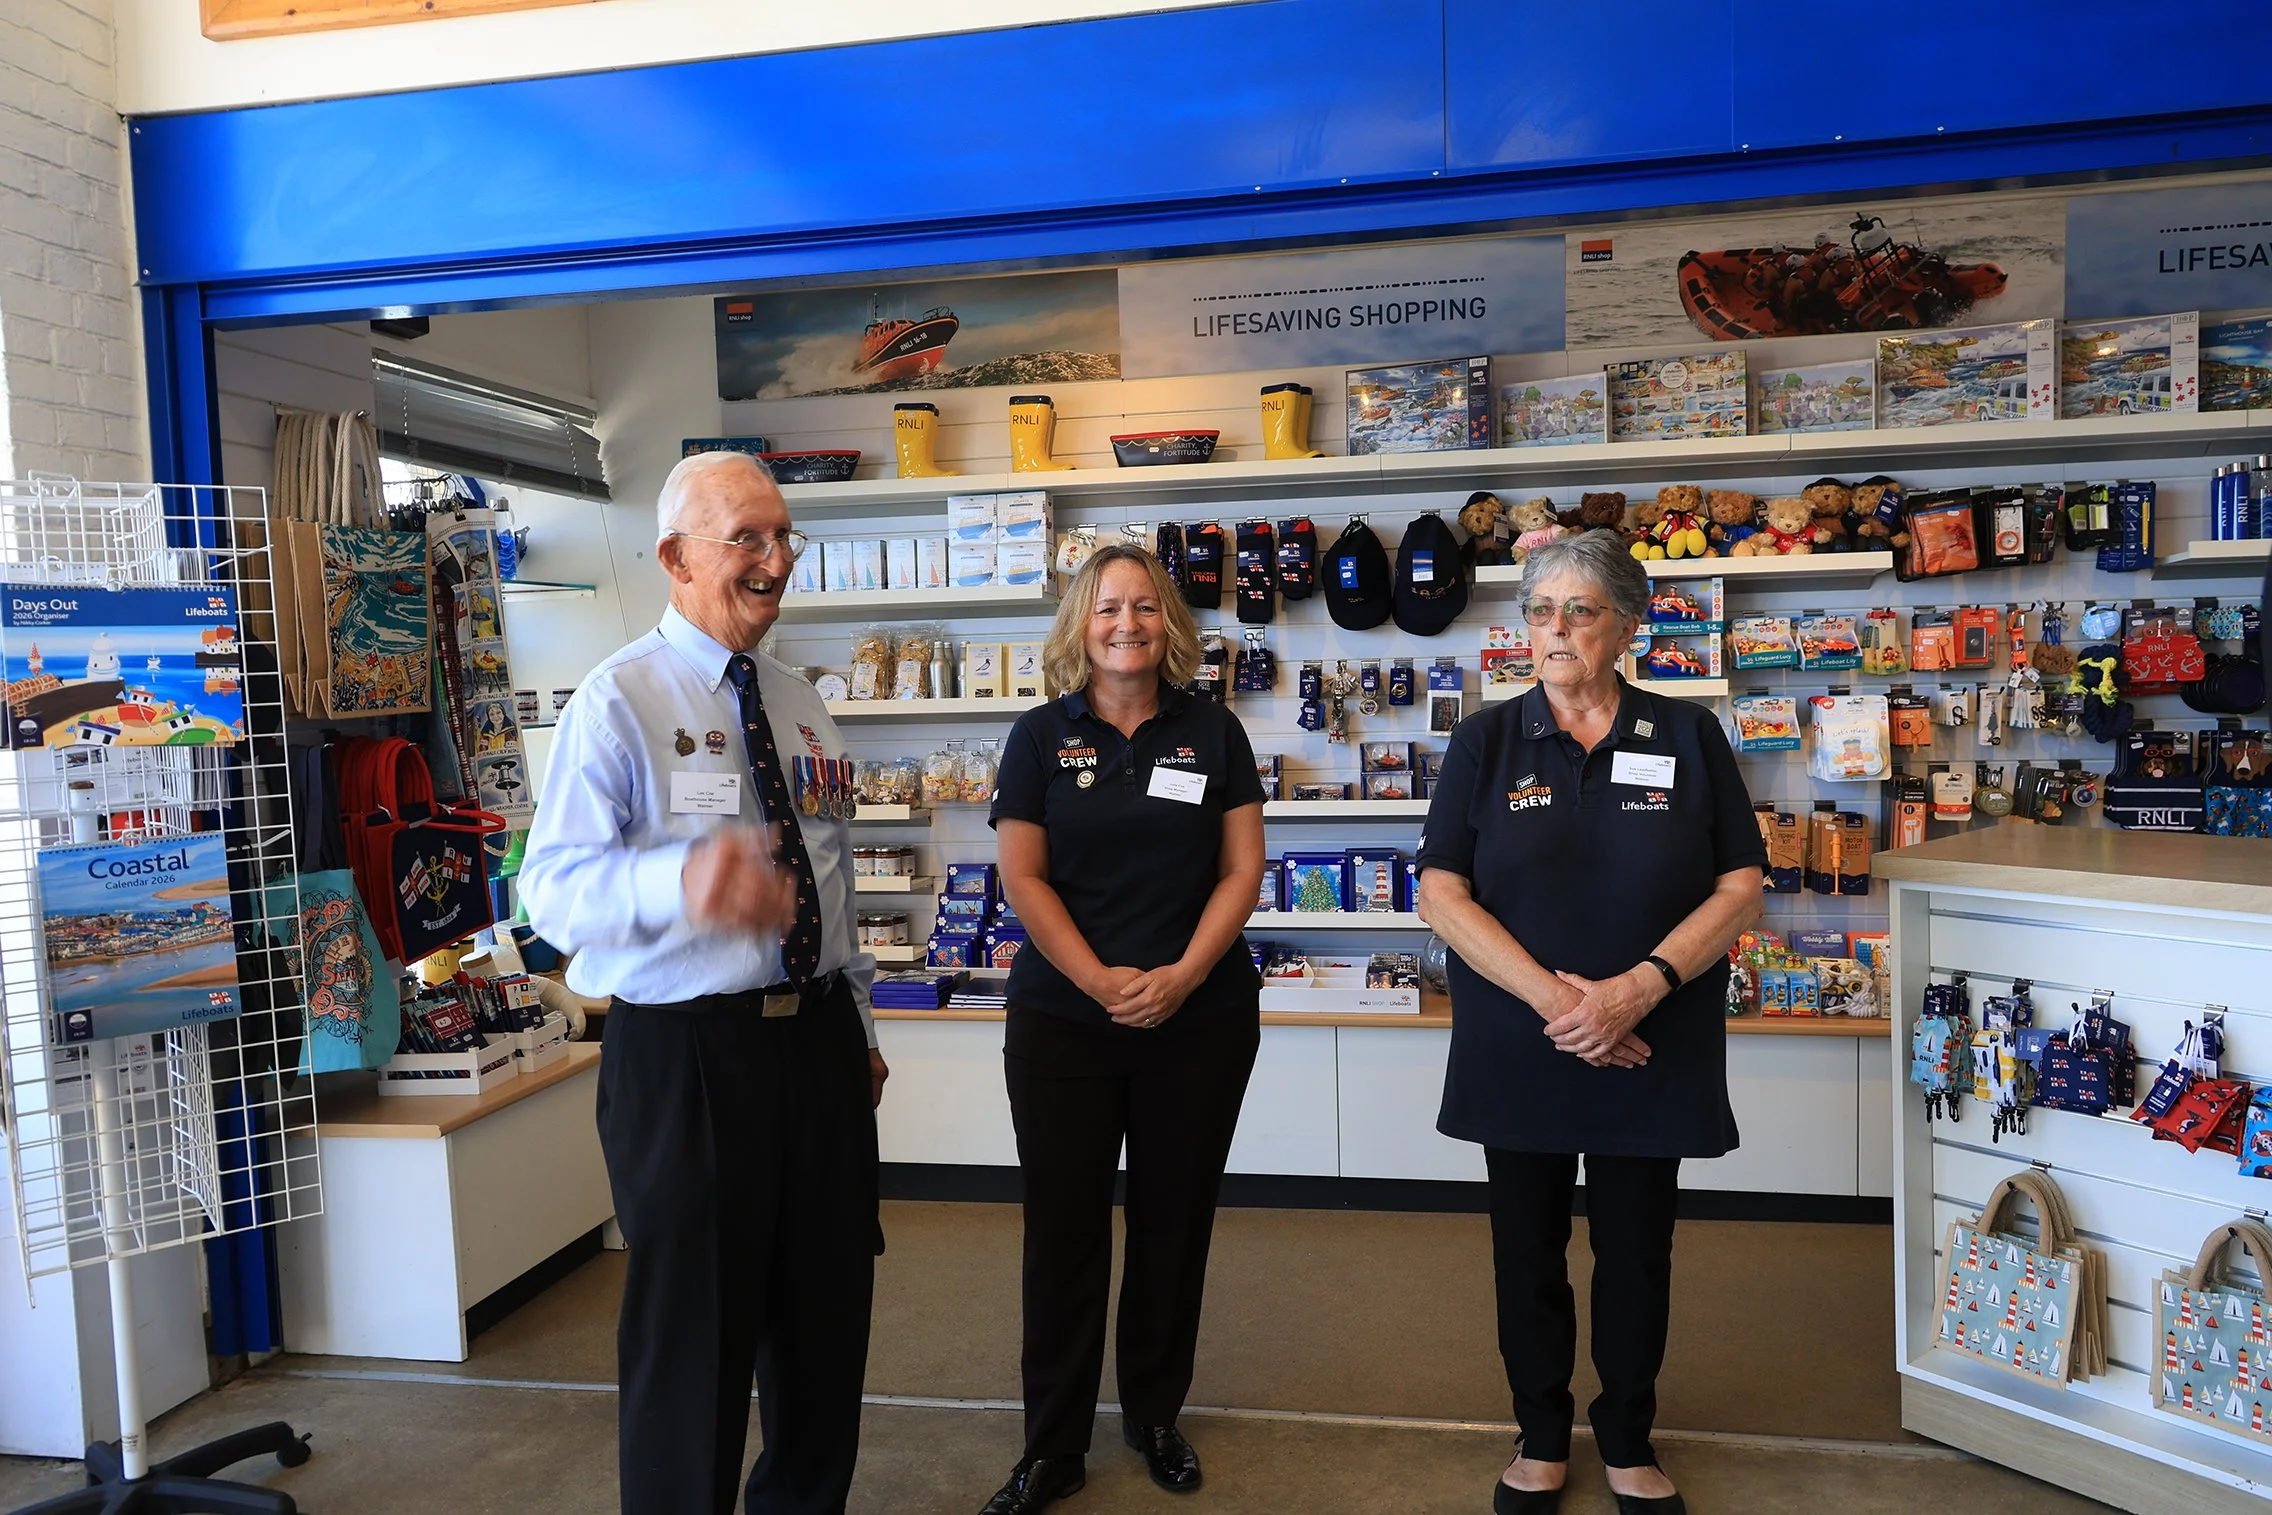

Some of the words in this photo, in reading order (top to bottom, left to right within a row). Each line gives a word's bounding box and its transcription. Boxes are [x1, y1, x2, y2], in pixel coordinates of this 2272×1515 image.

[1597, 252, 1611, 260] shop
[2159, 242, 2272, 273] LIFESA
[1193, 307, 1341, 337] LIFESAVING
[1349, 297, 1486, 327] SHOPPING
[900, 340, 914, 351] RNLI
[1262, 400, 1285, 413] RNLI
[897, 418, 924, 430] RNLI
[1012, 415, 1039, 425] RNLI
[1163, 449, 1201, 457] FORTITUDE
[806, 462, 836, 470] CHARITY,
[2237, 495, 2248, 523] RNLI
[1193, 574, 1217, 582] RNLI
[13, 598, 47, 613] Days
[50, 598, 79, 610] Out
[13, 612, 33, 620] 2026
[34, 612, 70, 621] Organiser
[185, 607, 228, 617] Lifeboats
[2147, 643, 2170, 652] RNLI
[1754, 655, 1779, 663] Lifeguard
[1846, 658, 1857, 666] Lily
[1066, 738, 1081, 747] SHOP
[1057, 747, 1097, 758] VOLUNTEER
[1060, 757, 1097, 768] CREW
[1155, 756, 1196, 766] Lifeboats
[1519, 777, 1534, 788] SHOP
[1508, 785, 1552, 800] VOLUNTEER
[1509, 794, 1552, 811] CREW
[1621, 801, 1669, 810] Lifeboats
[2138, 811, 2186, 825] RNLI
[87, 848, 190, 879] Coastal
[105, 877, 150, 890] Calendar
[151, 874, 176, 884] 2026
[182, 1004, 235, 1020] Lifeboats
[120, 1050, 148, 1060] Lifboats
[1919, 1055, 1935, 1064] RNLI
[2163, 1074, 2181, 1088] Lifeboats
